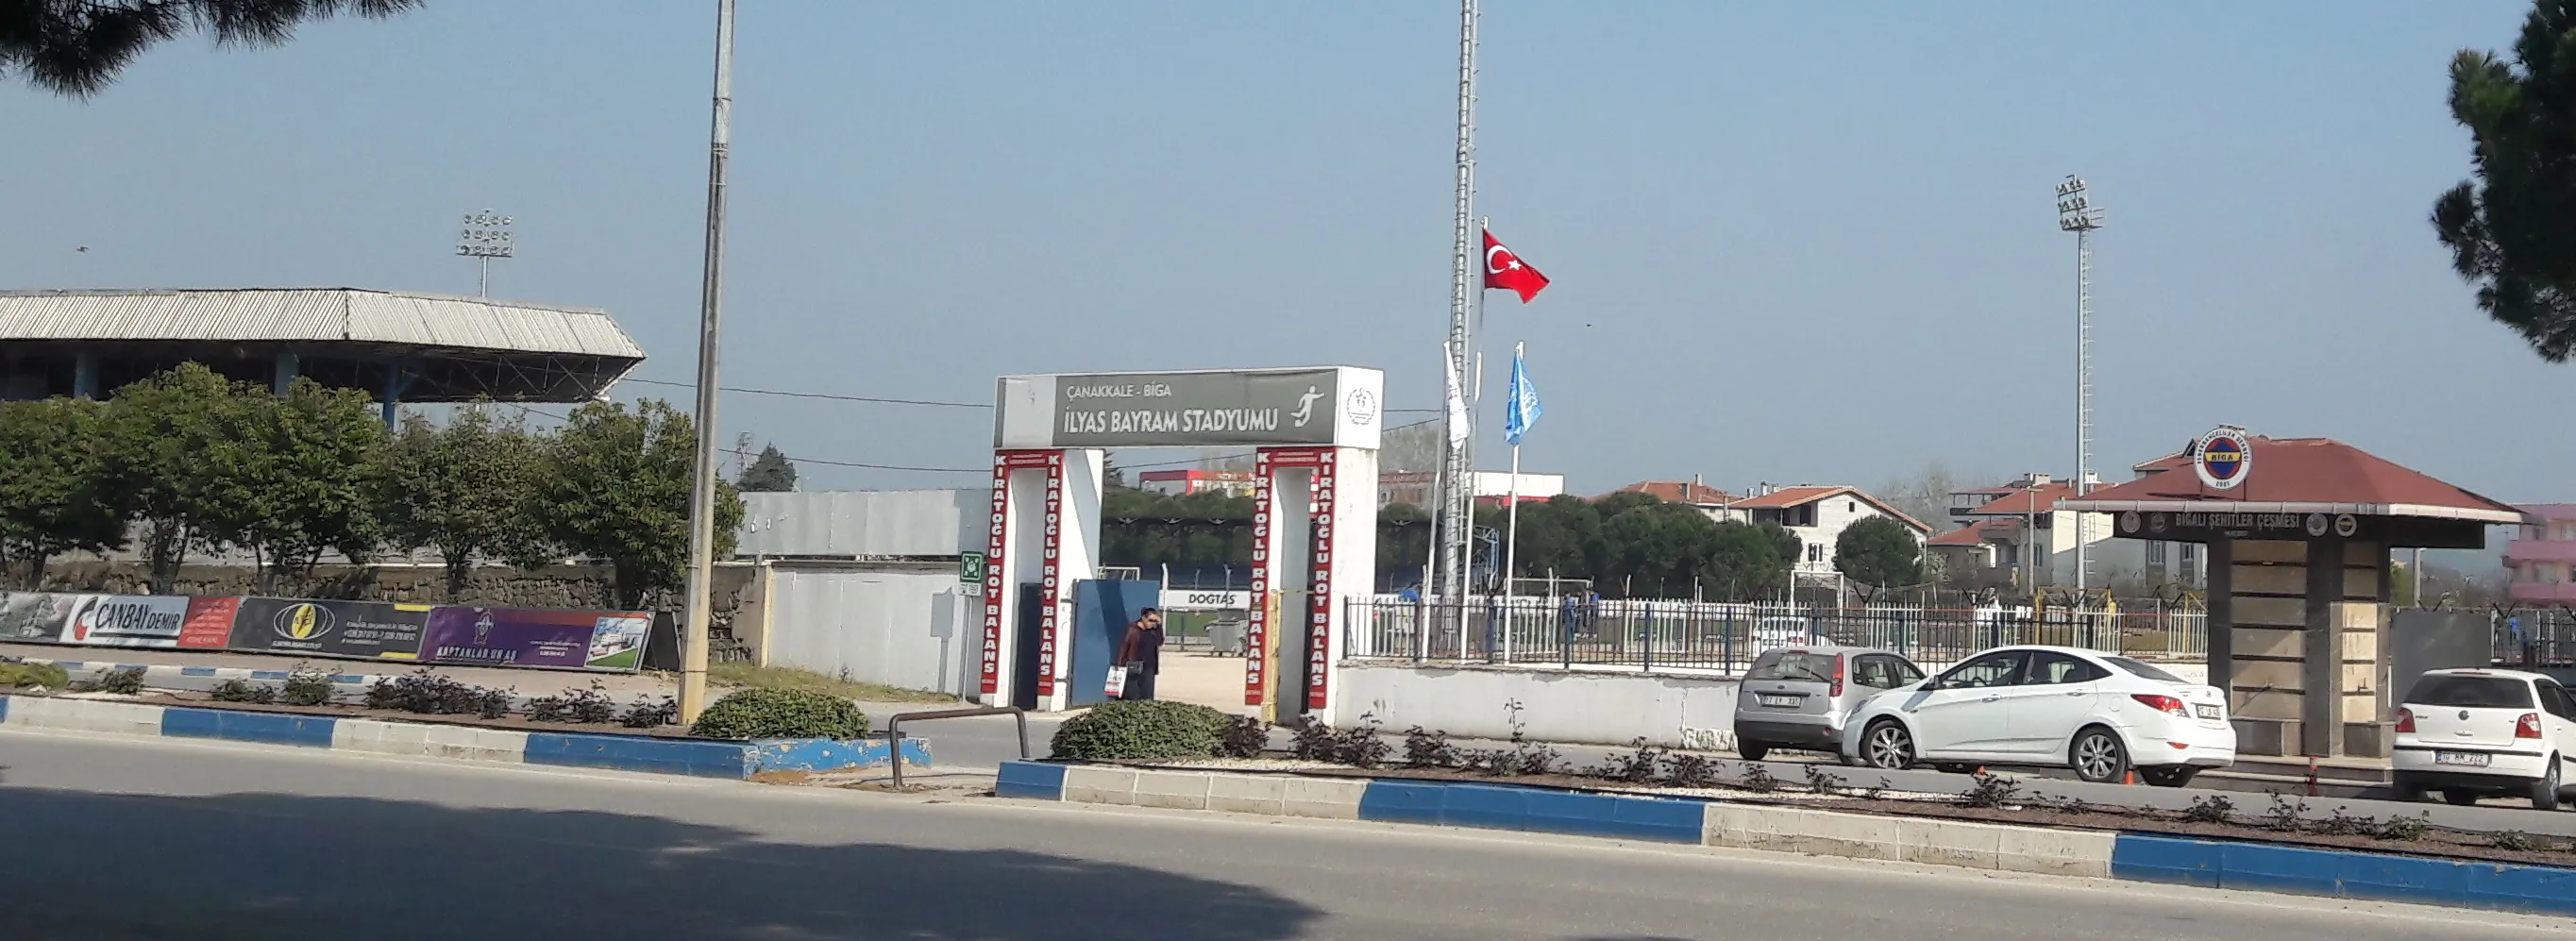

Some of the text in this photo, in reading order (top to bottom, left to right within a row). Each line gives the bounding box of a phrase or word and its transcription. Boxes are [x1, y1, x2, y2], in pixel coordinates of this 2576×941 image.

[1066, 384, 1134, 401] ÇANAKKALE
[1143, 380, 1172, 397] BİGA
[1064, 406, 1279, 433] İLYAS BAYRAM STADYUMU
[987, 564, 1001, 599] ROT
[1043, 565, 1055, 600] ROT
[1251, 567, 1265, 603] ROT
[1314, 570, 1328, 607] ROT
[95, 602, 151, 630] CANBAY
[984, 605, 999, 674] BALANS
[1039, 606, 1054, 676] BALANS
[1247, 611, 1263, 684] BALANS
[1311, 613, 1327, 686] BALANS
